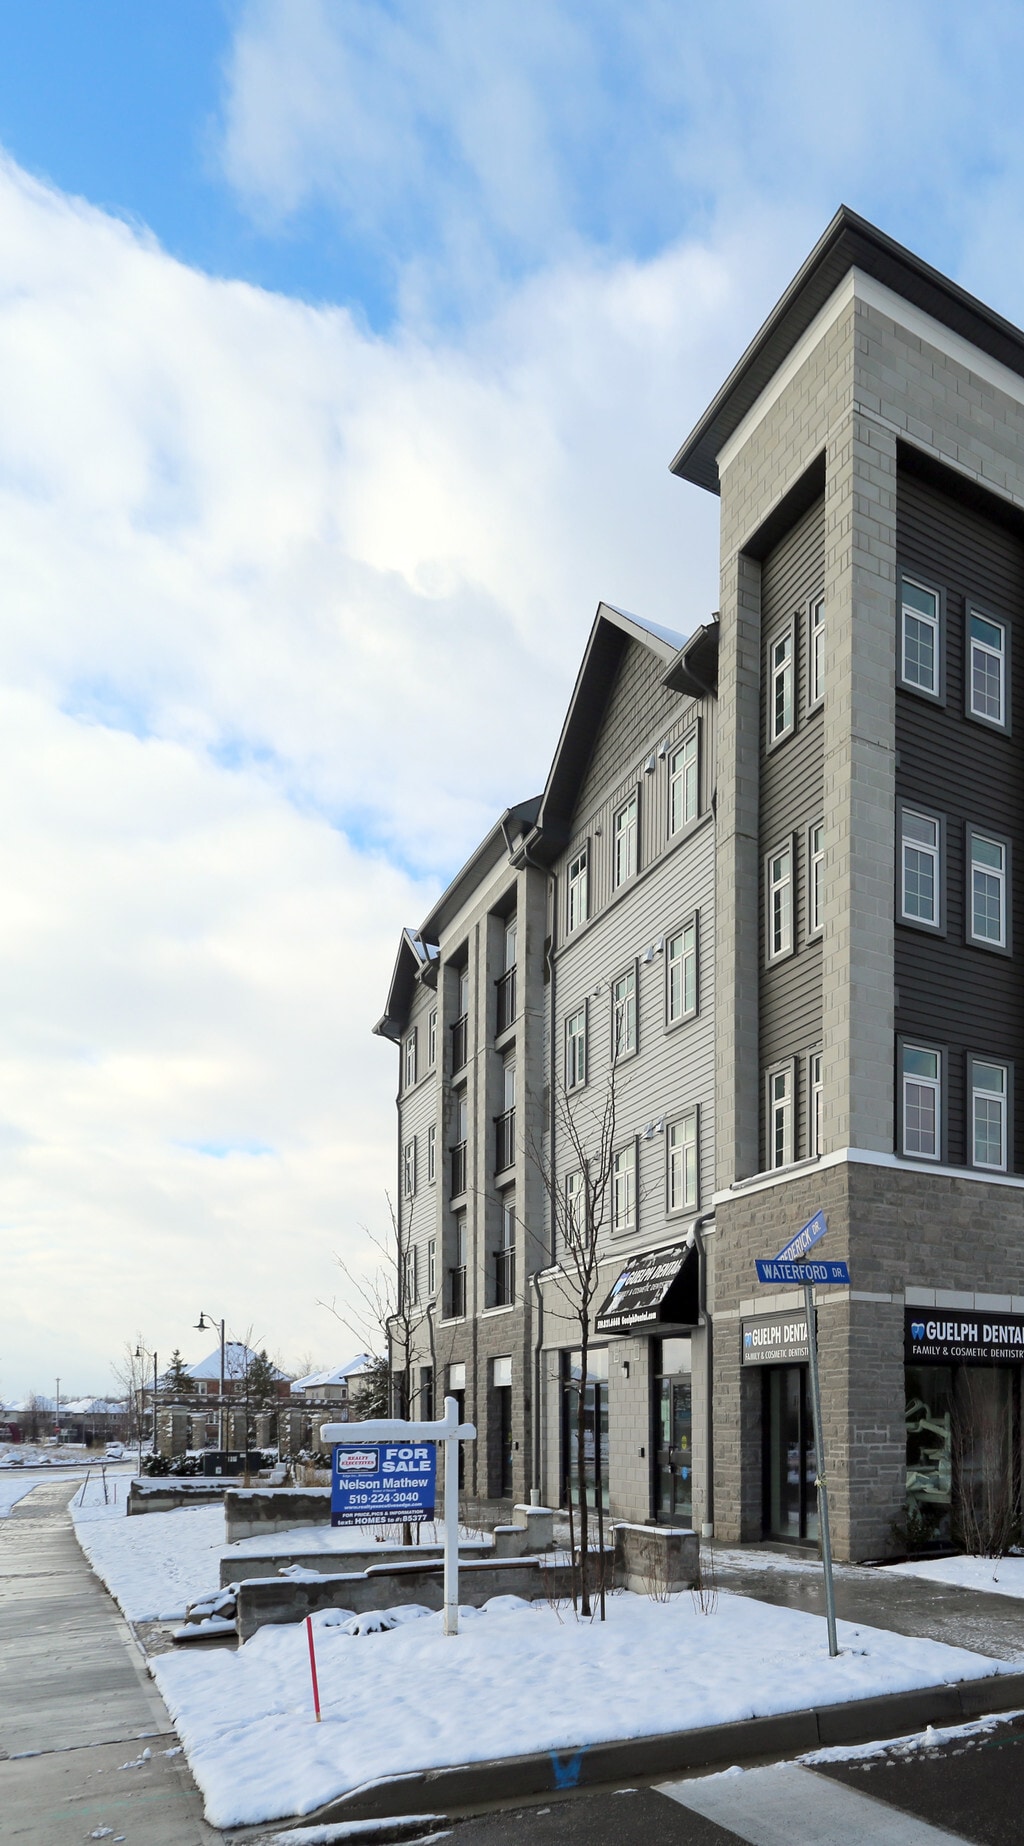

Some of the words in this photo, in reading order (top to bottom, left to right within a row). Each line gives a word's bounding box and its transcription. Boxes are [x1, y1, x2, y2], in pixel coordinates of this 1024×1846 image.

[811, 1221, 821, 1236] DR.
[625, 1266, 658, 1287] GUELPH
[762, 1264, 828, 1280] WATERFORD
[831, 1267, 846, 1278] DR.
[752, 1325, 782, 1346] GUELPH
[784, 1322, 808, 1343] DENTA
[926, 1321, 978, 1342] GUELPH
[745, 1352, 760, 1361] FAMILY
[761, 1351, 765, 1360] &
[765, 1349, 787, 1359] COSMETIC
[788, 1347, 809, 1357] DENTIST
[912, 1345, 940, 1355] FAMILY
[942, 1346, 949, 1356] &
[951, 1347, 988, 1357] COSMETIC
[386, 1448, 428, 1460] FOR
[382, 1461, 431, 1473] SALE
[339, 1479, 380, 1490] Nelson
[382, 1477, 429, 1489] Mathew
[354, 1516, 387, 1525] HOMES
